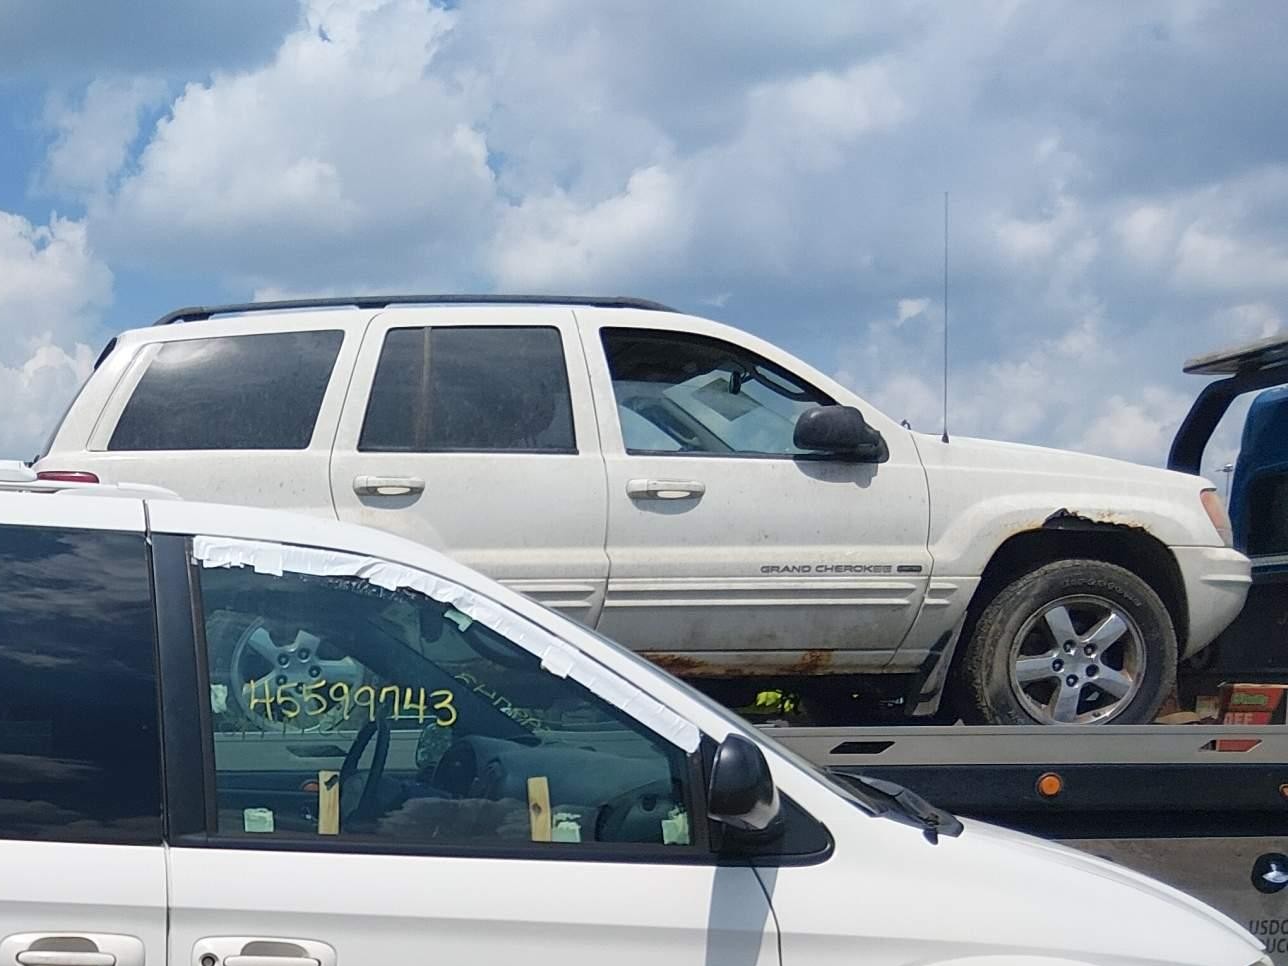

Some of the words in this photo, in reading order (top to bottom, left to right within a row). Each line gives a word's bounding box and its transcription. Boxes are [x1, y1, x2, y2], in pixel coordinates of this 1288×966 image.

[760, 564, 812, 574] GRAND
[815, 564, 893, 574] CHEROKEE
[247, 678, 458, 727] 45599743
